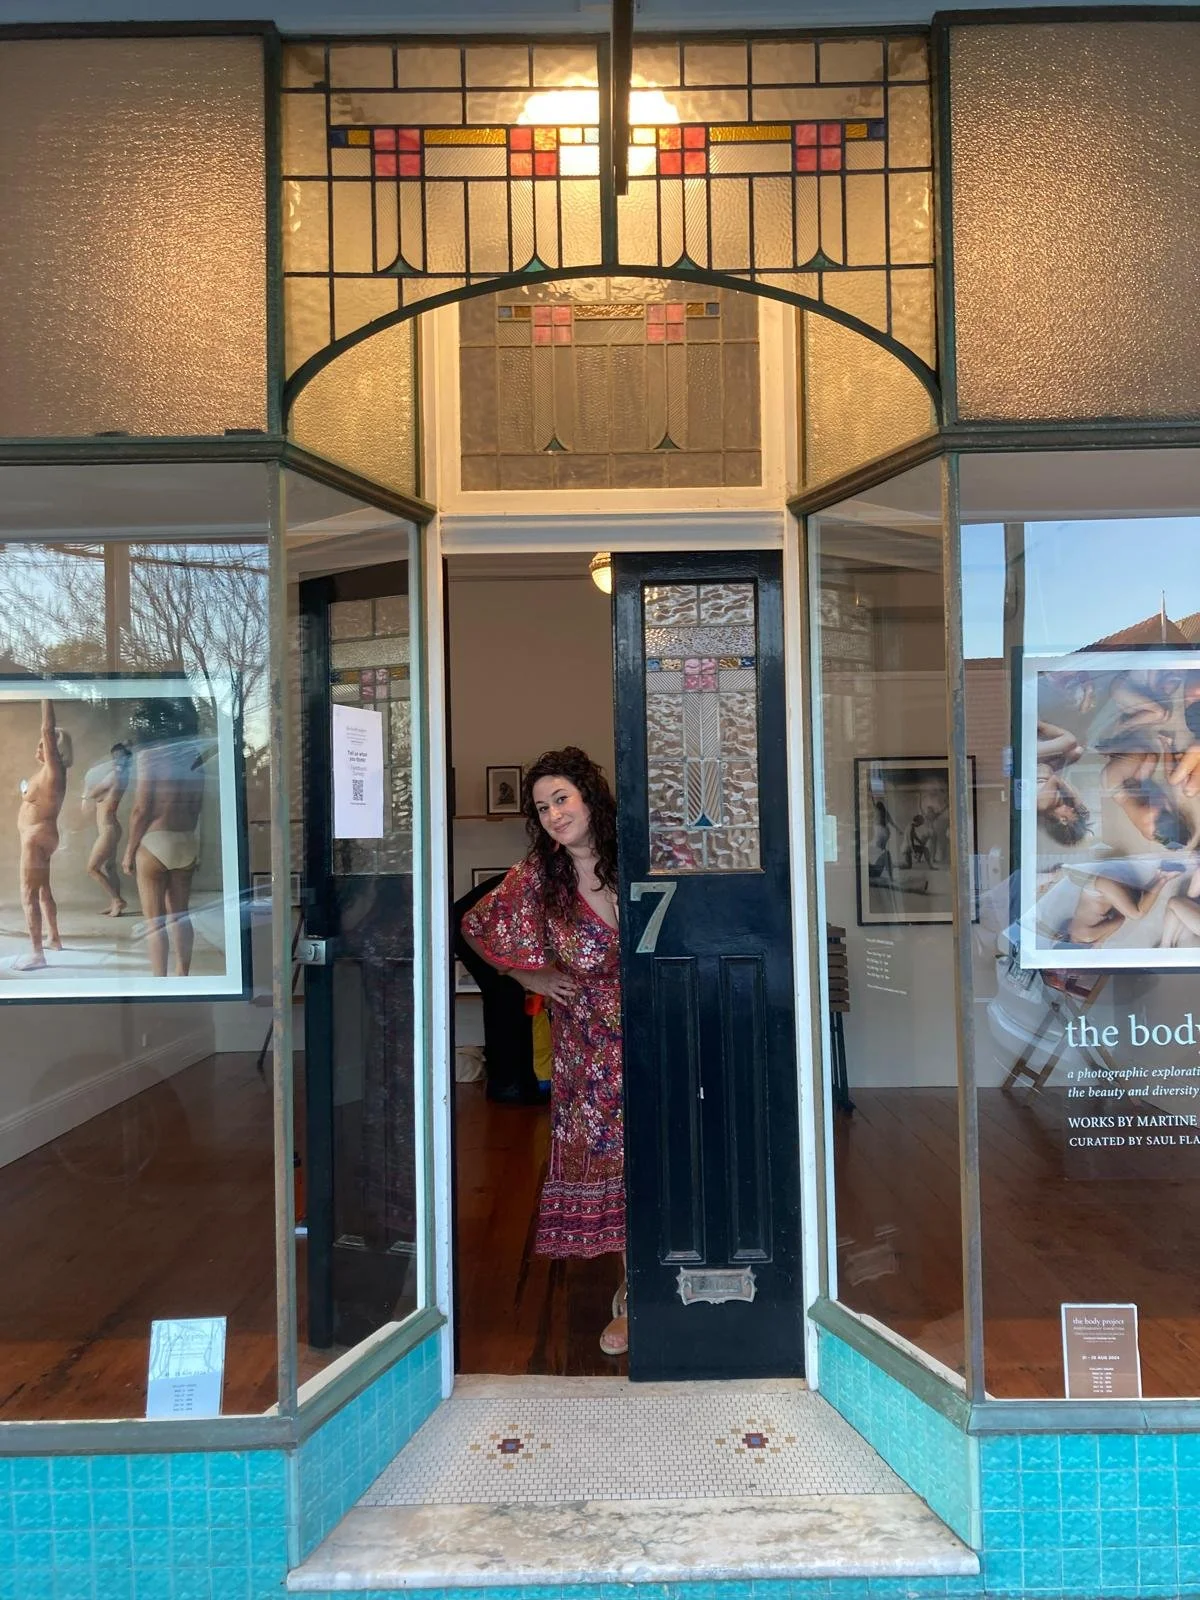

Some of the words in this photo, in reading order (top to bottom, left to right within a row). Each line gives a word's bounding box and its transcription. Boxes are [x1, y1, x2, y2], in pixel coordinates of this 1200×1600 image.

[630, 882, 677, 953] 7
[1065, 1015, 1119, 1048] the
[1128, 1012, 1200, 1054] bod
[1077, 1066, 1148, 1081] photographic
[1068, 1087, 1085, 1098] the
[1088, 1086, 1125, 1099] beauty
[1128, 1085, 1149, 1096] and
[1152, 1084, 1200, 1098] diversity
[1068, 1116, 1115, 1128] WORKS
[1118, 1116, 1134, 1127] BY
[1137, 1115, 1197, 1127] MARTINE
[1069, 1137, 1125, 1147] CURATED
[1128, 1136, 1143, 1146] BY
[1146, 1135, 1176, 1146] SAUL
[1179, 1135, 1200, 1145] FLA
[1072, 1316, 1083, 1325] the
[1084, 1316, 1101, 1327] body
[1102, 1318, 1124, 1327] project
